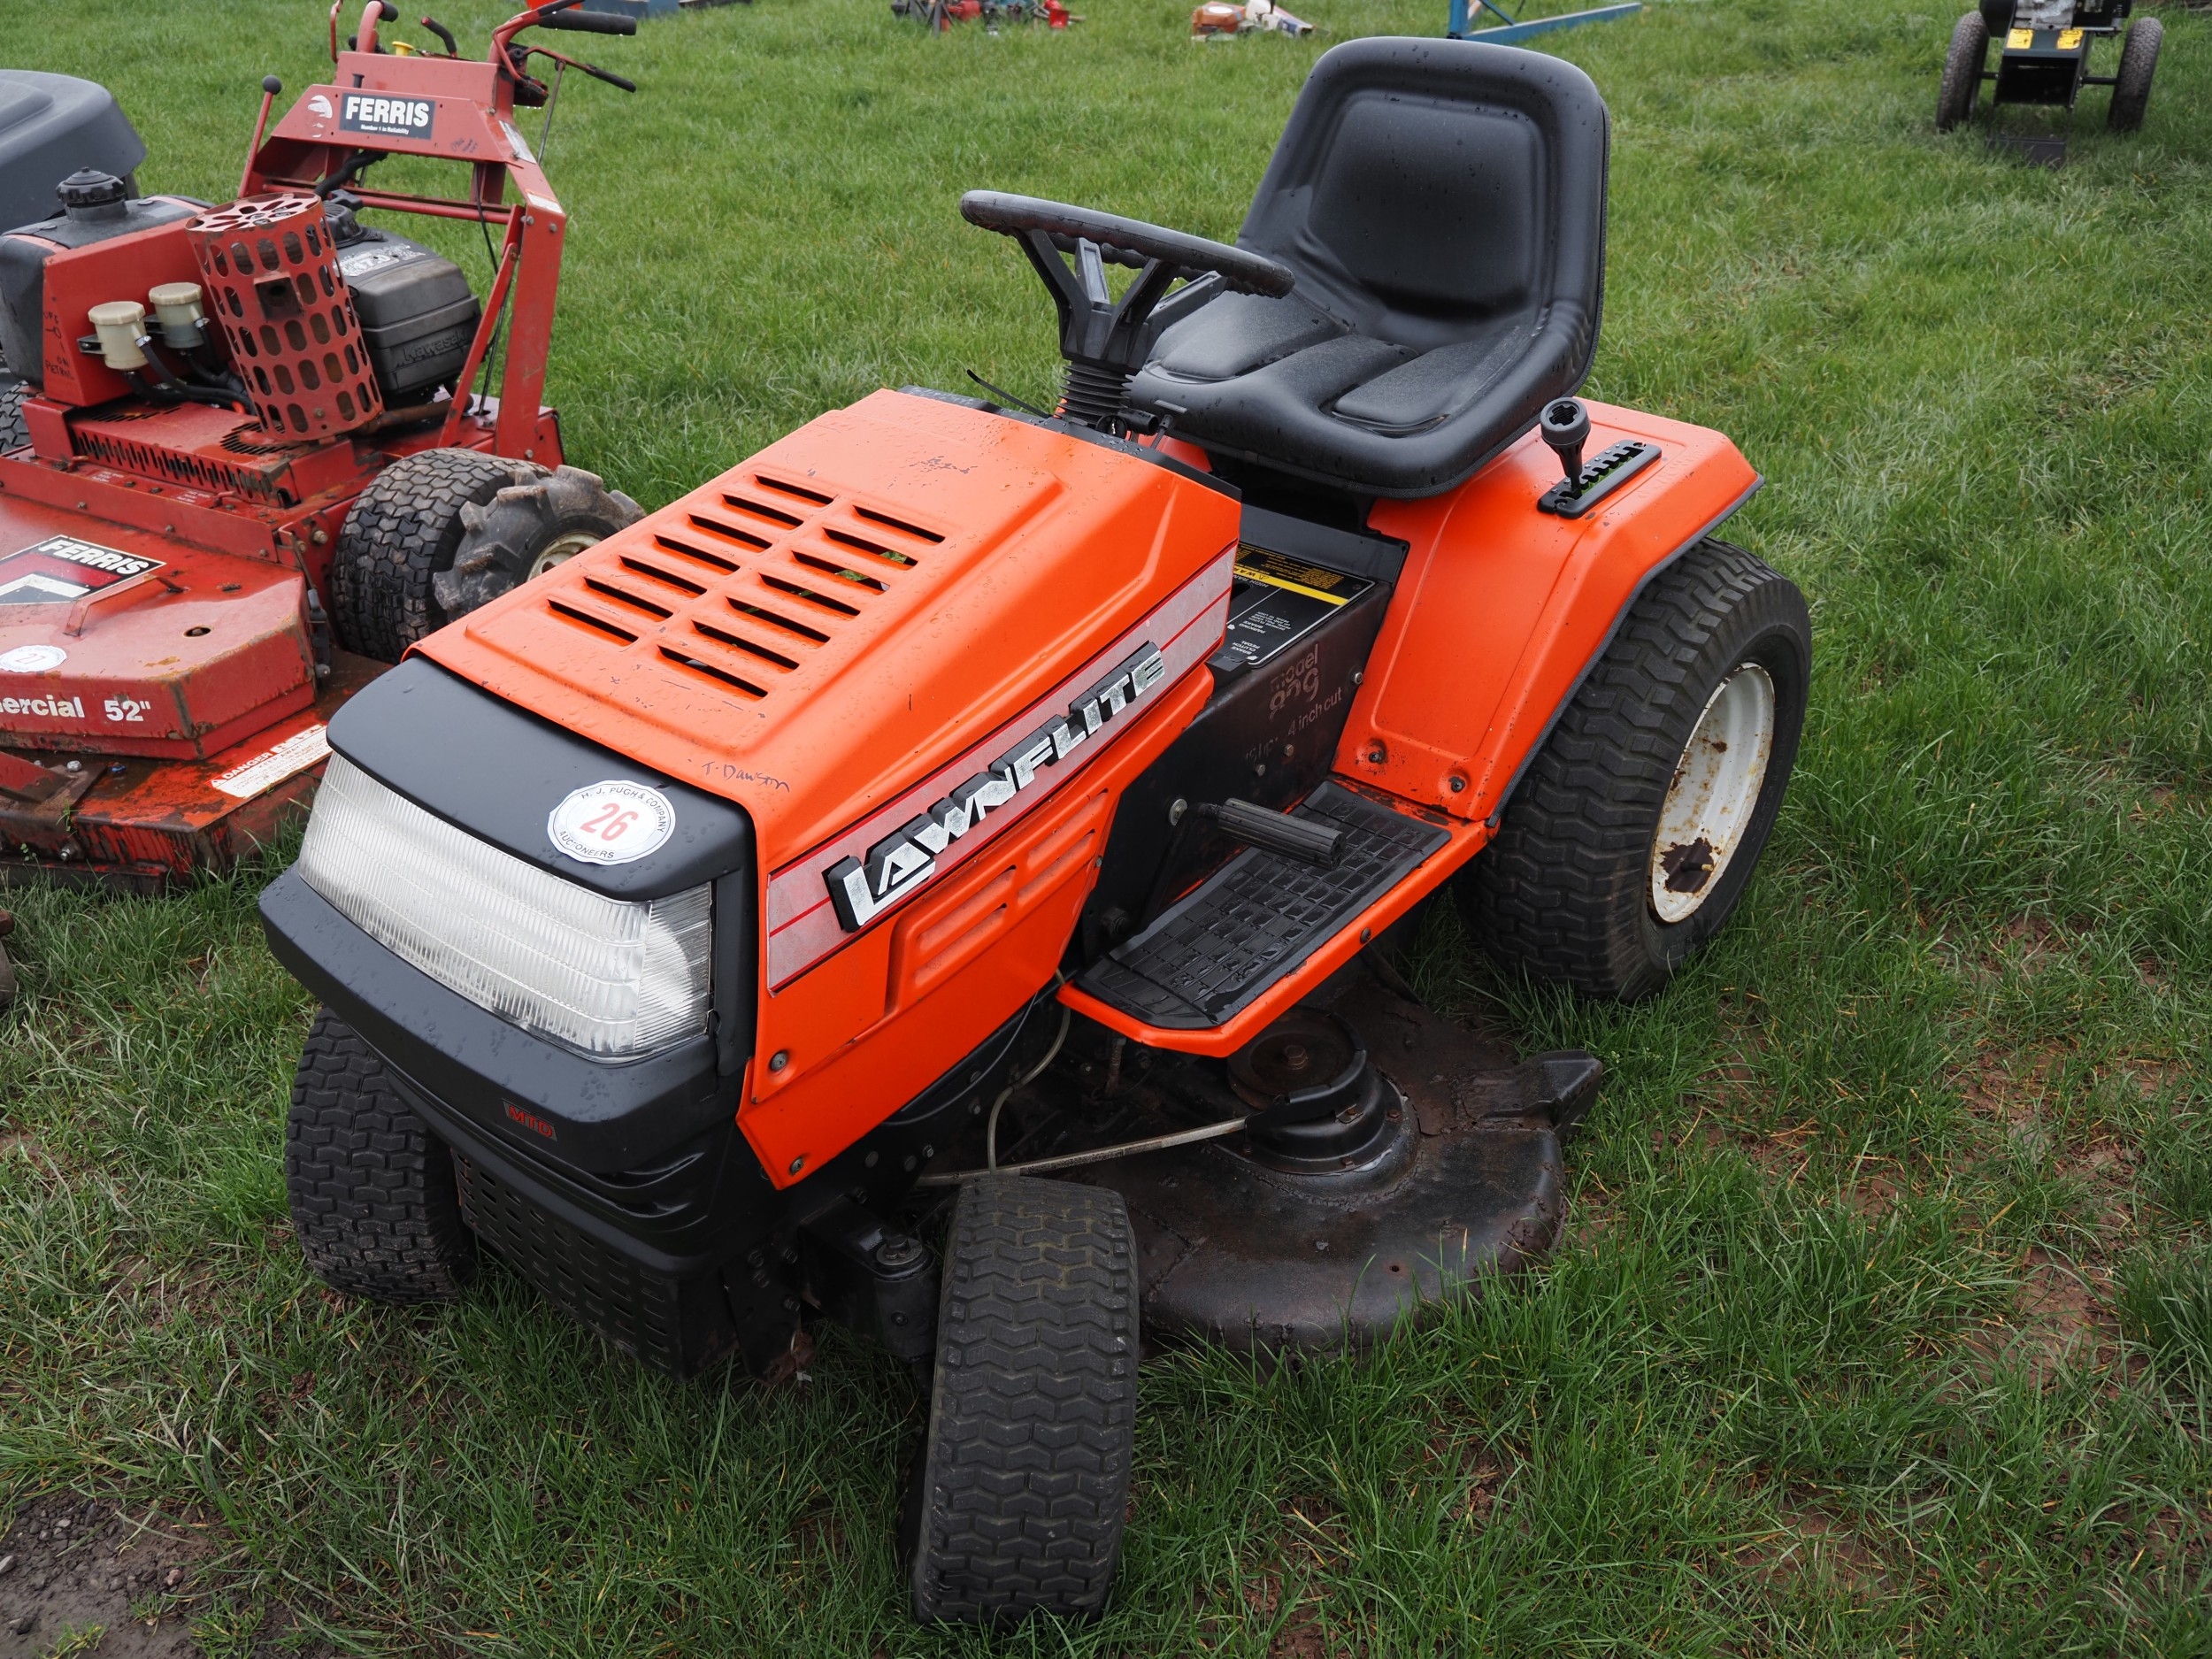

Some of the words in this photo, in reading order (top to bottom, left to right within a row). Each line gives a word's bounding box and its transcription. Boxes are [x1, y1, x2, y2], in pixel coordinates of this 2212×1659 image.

[346, 96, 430, 127] FERRIS
[403, 328, 469, 364] Kawasaki
[38, 540, 150, 575] FERRIS
[0, 695, 86, 718] ercial
[104, 699, 151, 721] 52"
[1299, 703, 1323, 731] inch
[1324, 687, 1342, 711] cut
[222, 751, 273, 780] DANGER
[827, 643, 1165, 930] LAWNFLITE
[580, 803, 639, 841] 26
[609, 787, 639, 797] PUGH
[645, 797, 667, 833] COMPANY
[559, 830, 615, 859] AUCTIONEERS
[509, 1105, 553, 1138] MTD
